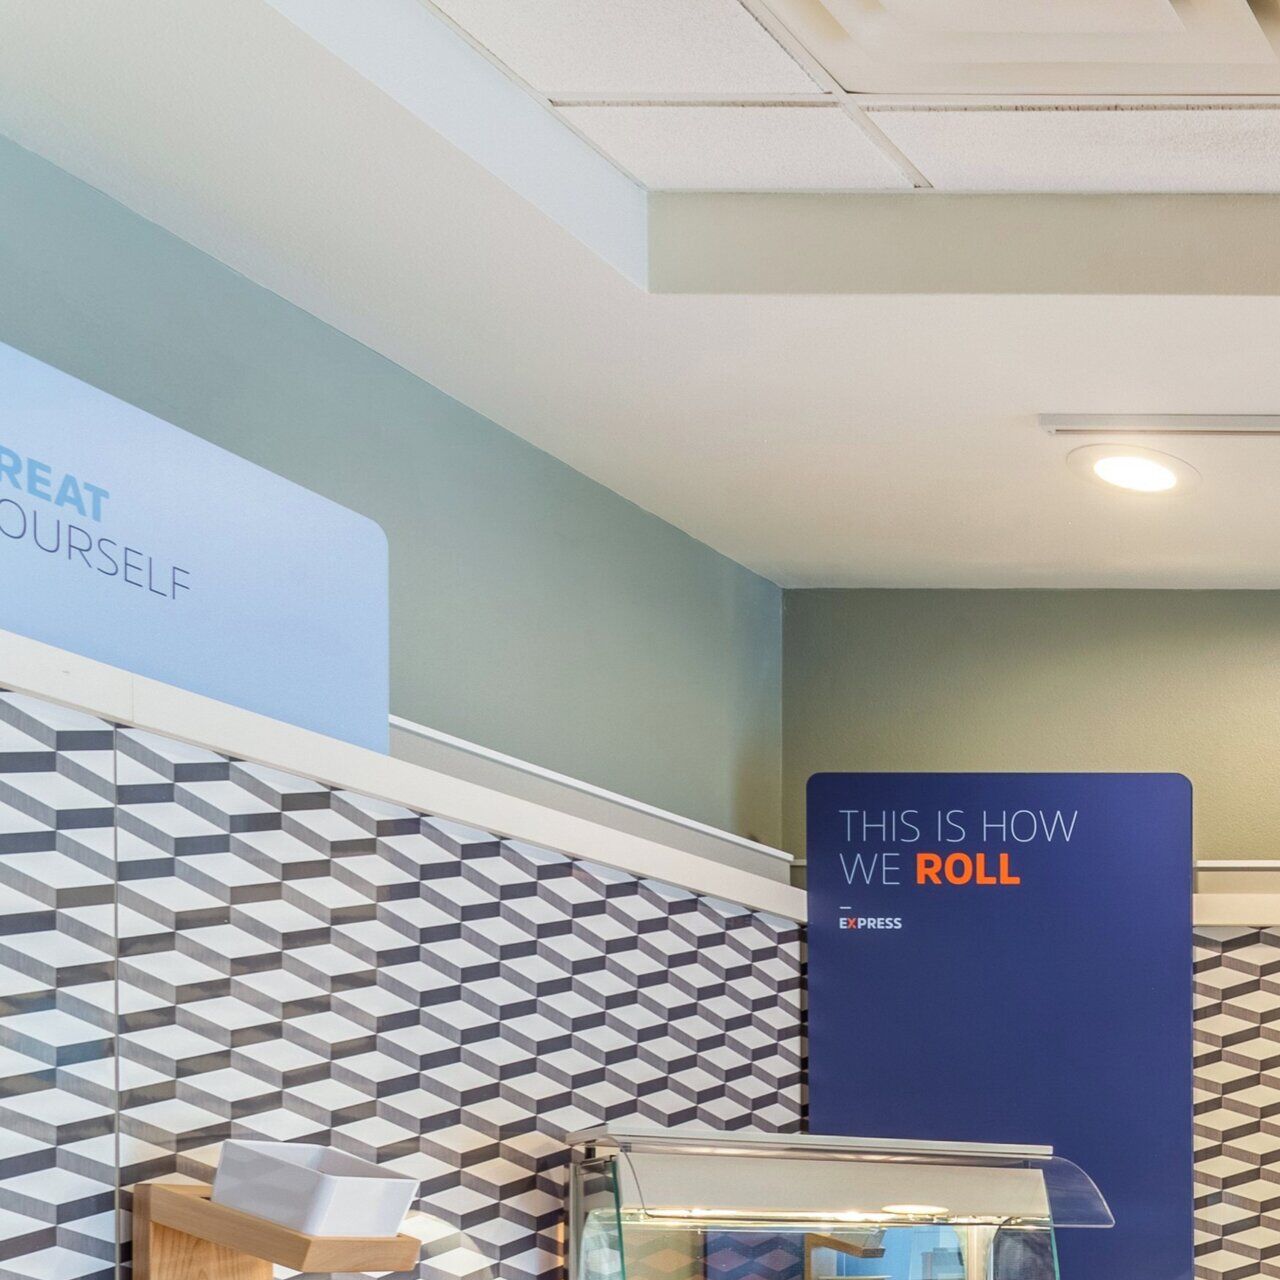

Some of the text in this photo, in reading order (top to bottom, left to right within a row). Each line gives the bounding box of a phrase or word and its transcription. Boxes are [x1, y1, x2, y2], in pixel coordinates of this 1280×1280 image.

[0, 444, 110, 522] REAT
[0, 497, 191, 600] OURSELF
[838, 809, 1078, 843] THIS IS HOW
[839, 852, 1021, 886] WE ROLL
[838, 917, 902, 929] EXPRESS
